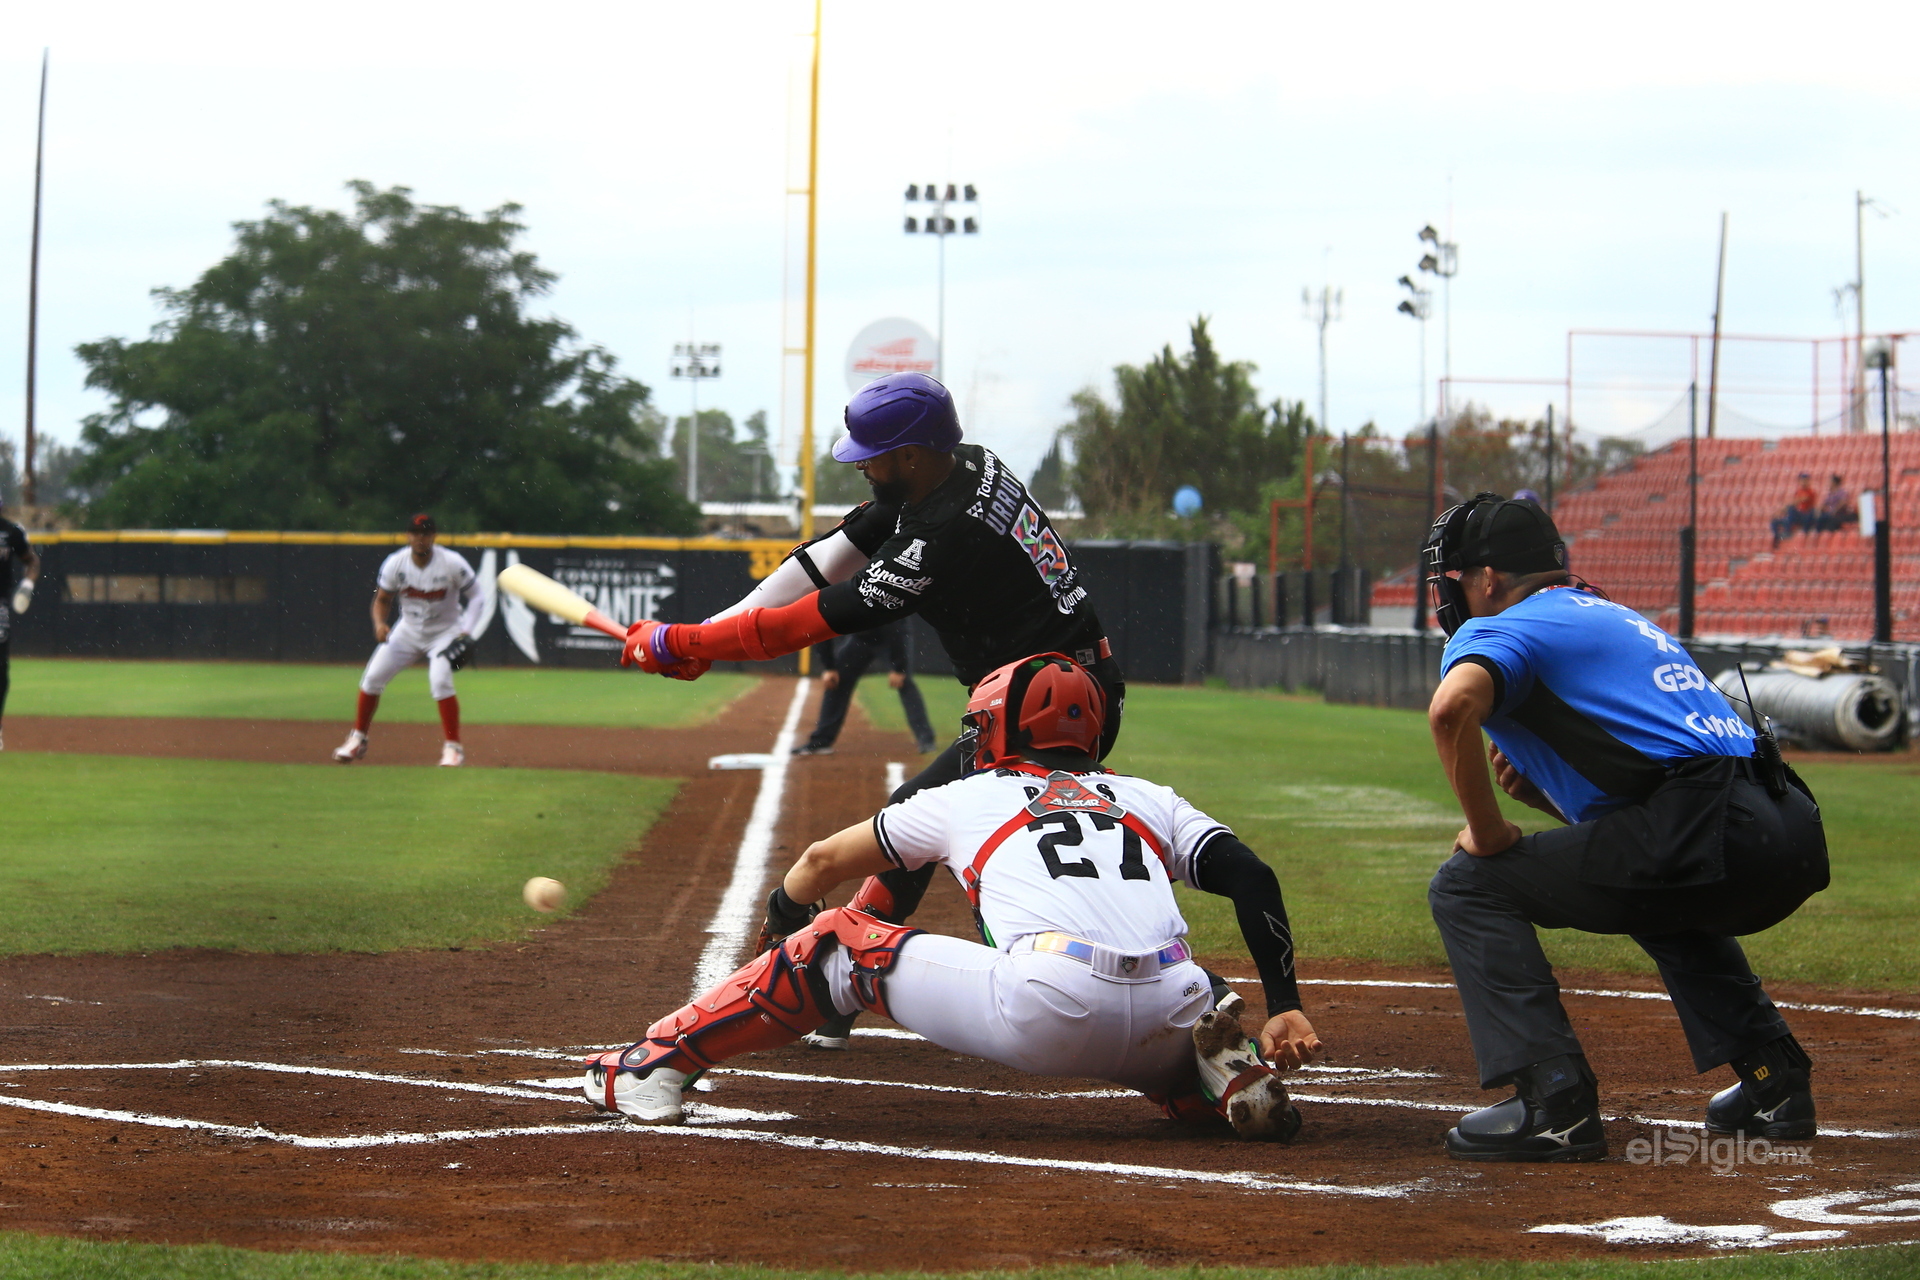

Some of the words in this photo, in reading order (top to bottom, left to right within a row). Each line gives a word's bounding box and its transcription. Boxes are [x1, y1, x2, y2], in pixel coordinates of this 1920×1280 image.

[865, 560, 934, 592] Lyncott
[1049, 797, 1101, 807] ALL-STAR
[1027, 811, 1150, 881] 27
